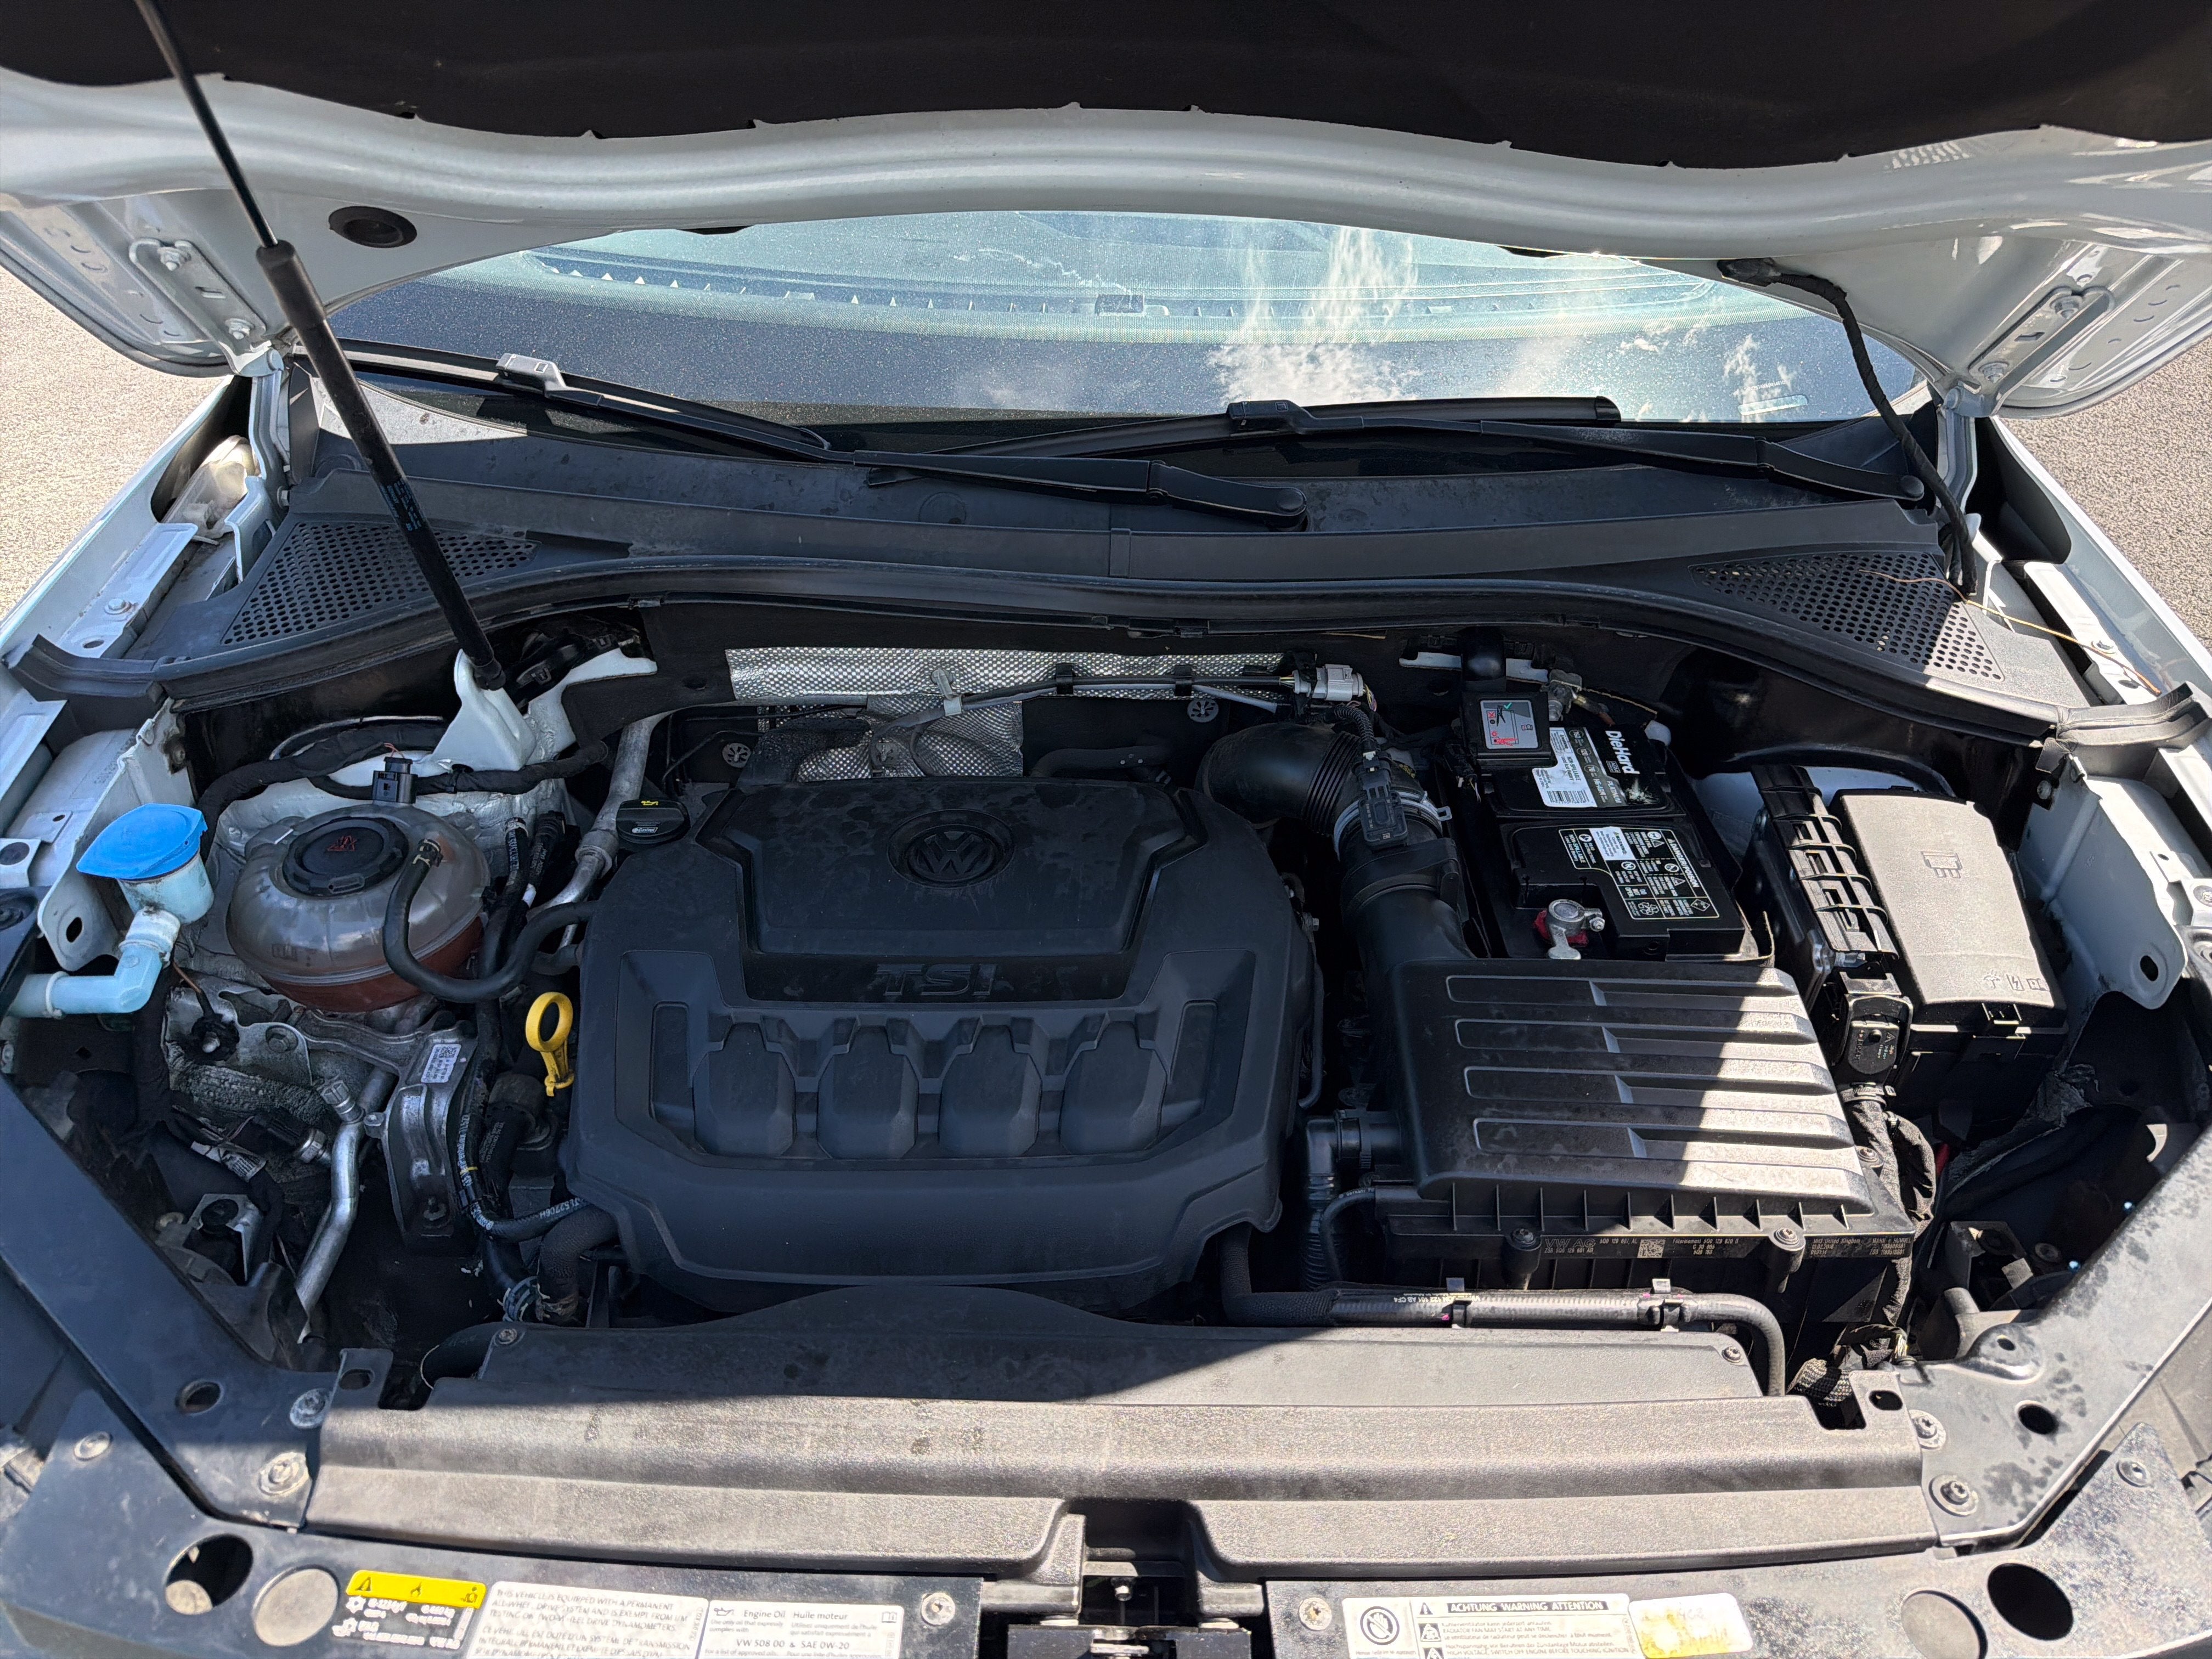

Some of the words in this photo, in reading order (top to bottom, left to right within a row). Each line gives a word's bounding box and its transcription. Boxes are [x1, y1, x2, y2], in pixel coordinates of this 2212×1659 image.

[1605, 730, 1640, 774] DieHard
[1606, 781, 1621, 803] PLATINUM
[1568, 834, 1585, 862] NON-SPILLABLE
[1669, 843, 1700, 887] DANGER/POISON
[877, 963, 997, 996] TSI
[1545, 1239, 1570, 1248] VW
[1573, 1239, 1596, 1248] AG
[626, 1600, 674, 1610] PERMANENT
[743, 1610, 772, 1619] Engine
[1450, 1604, 1497, 1612] ACHTUNG
[1550, 1601, 1604, 1610] ATTENTION
